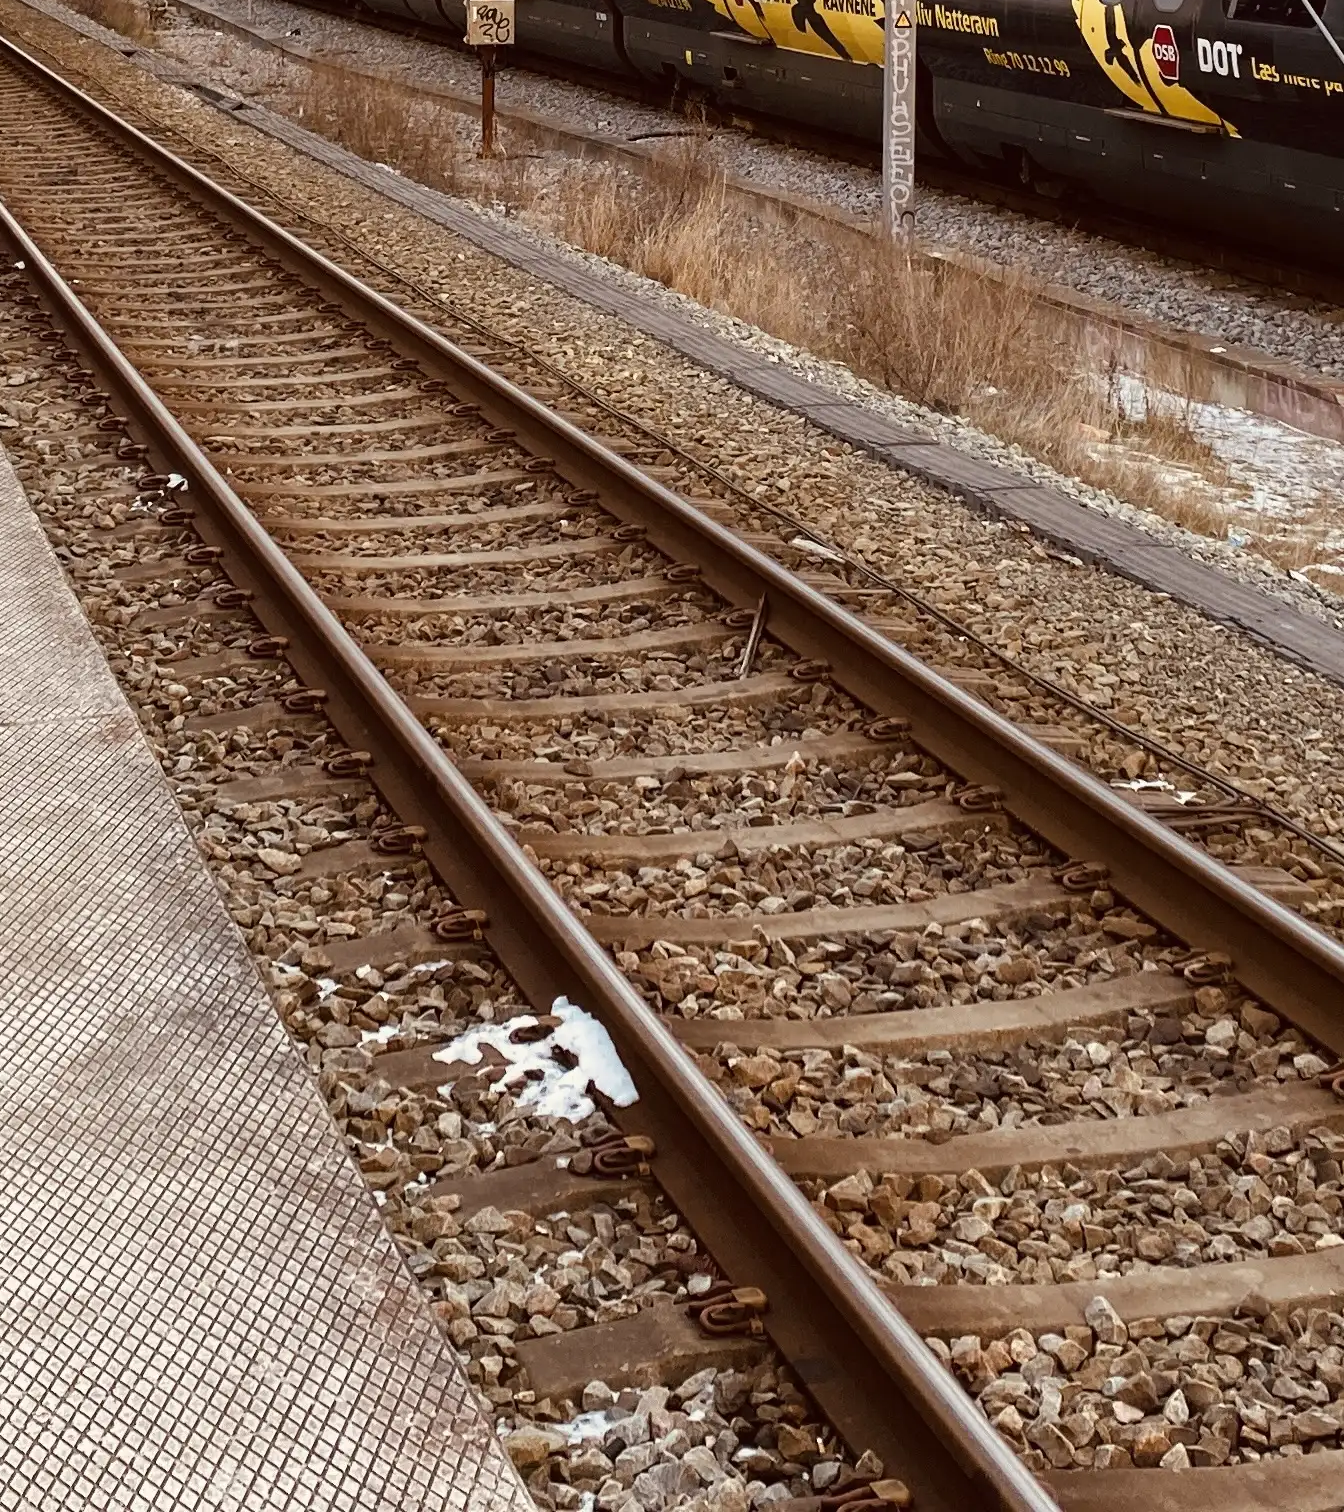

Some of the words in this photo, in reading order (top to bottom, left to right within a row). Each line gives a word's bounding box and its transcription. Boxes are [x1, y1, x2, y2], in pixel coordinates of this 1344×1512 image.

[916, 1, 932, 28] liv
[934, 3, 1000, 37] Natteravn
[983, 47, 1012, 71] Ring
[1006, 51, 1024, 70] 70
[1022, 54, 1041, 72] 12
[1037, 57, 1057, 76] 12
[1053, 58, 1071, 78] 99
[1155, 43, 1175, 62] DSB
[1197, 37, 1243, 79] DOT
[1251, 56, 1280, 83] Læs
